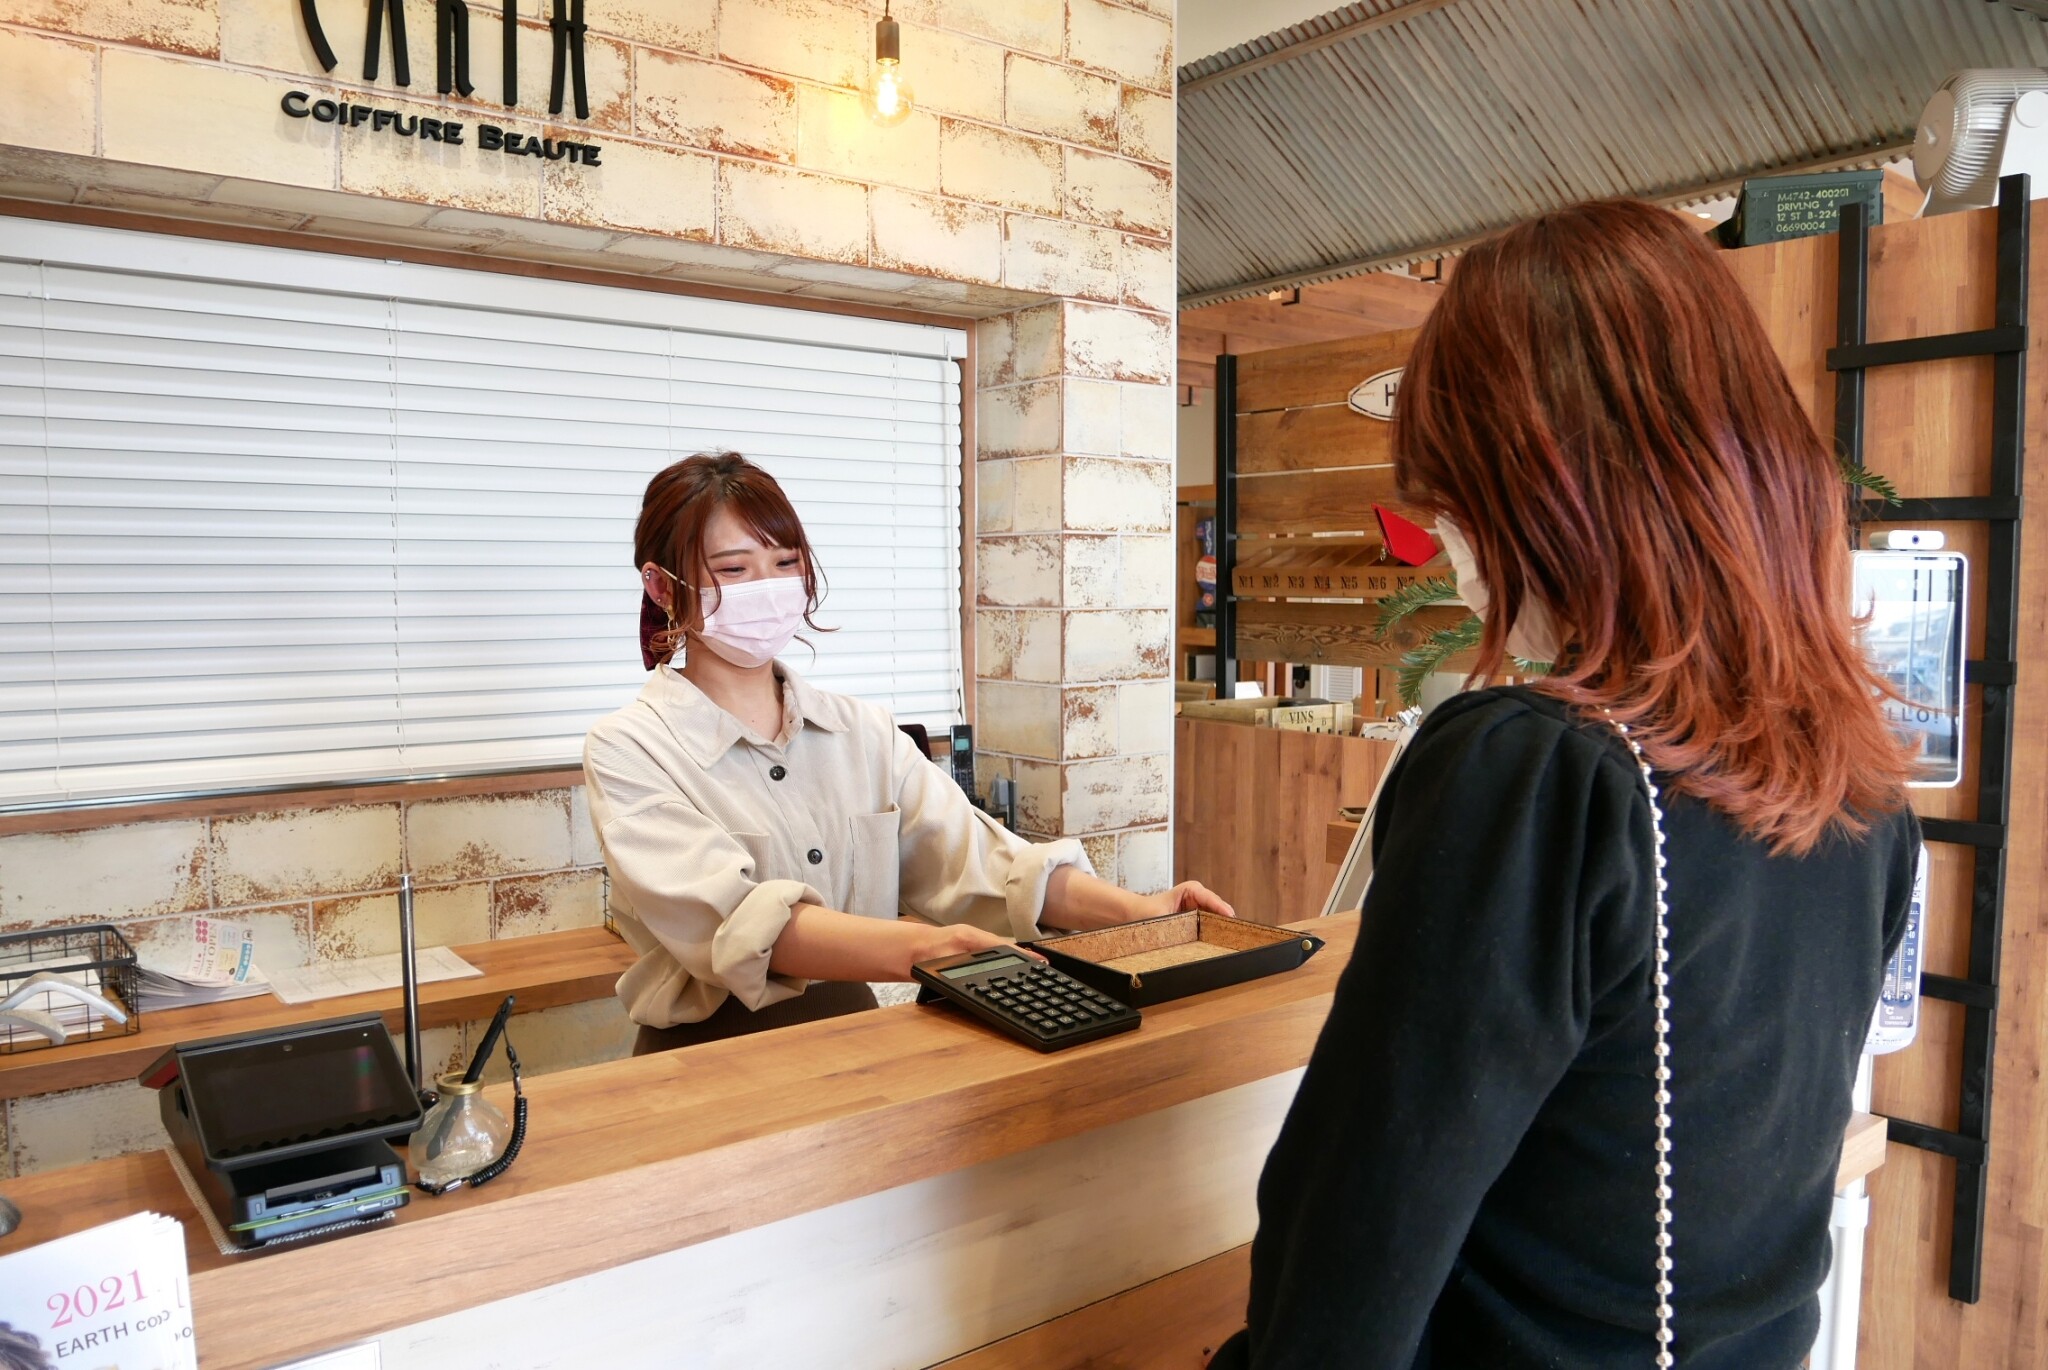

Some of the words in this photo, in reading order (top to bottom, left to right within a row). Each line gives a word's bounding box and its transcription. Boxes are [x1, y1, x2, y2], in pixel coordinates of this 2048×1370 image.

[281, 90, 463, 145] COIFFURE
[478, 124, 602, 167] BEAUTE
[1776, 212, 1786, 222] 12
[1790, 211, 1802, 221] ST
[1776, 220, 1826, 232] 06690004
[1289, 710, 1314, 724] VINS
[47, 1268, 148, 1329] 2021
[56, 1321, 129, 1359] EARTH
